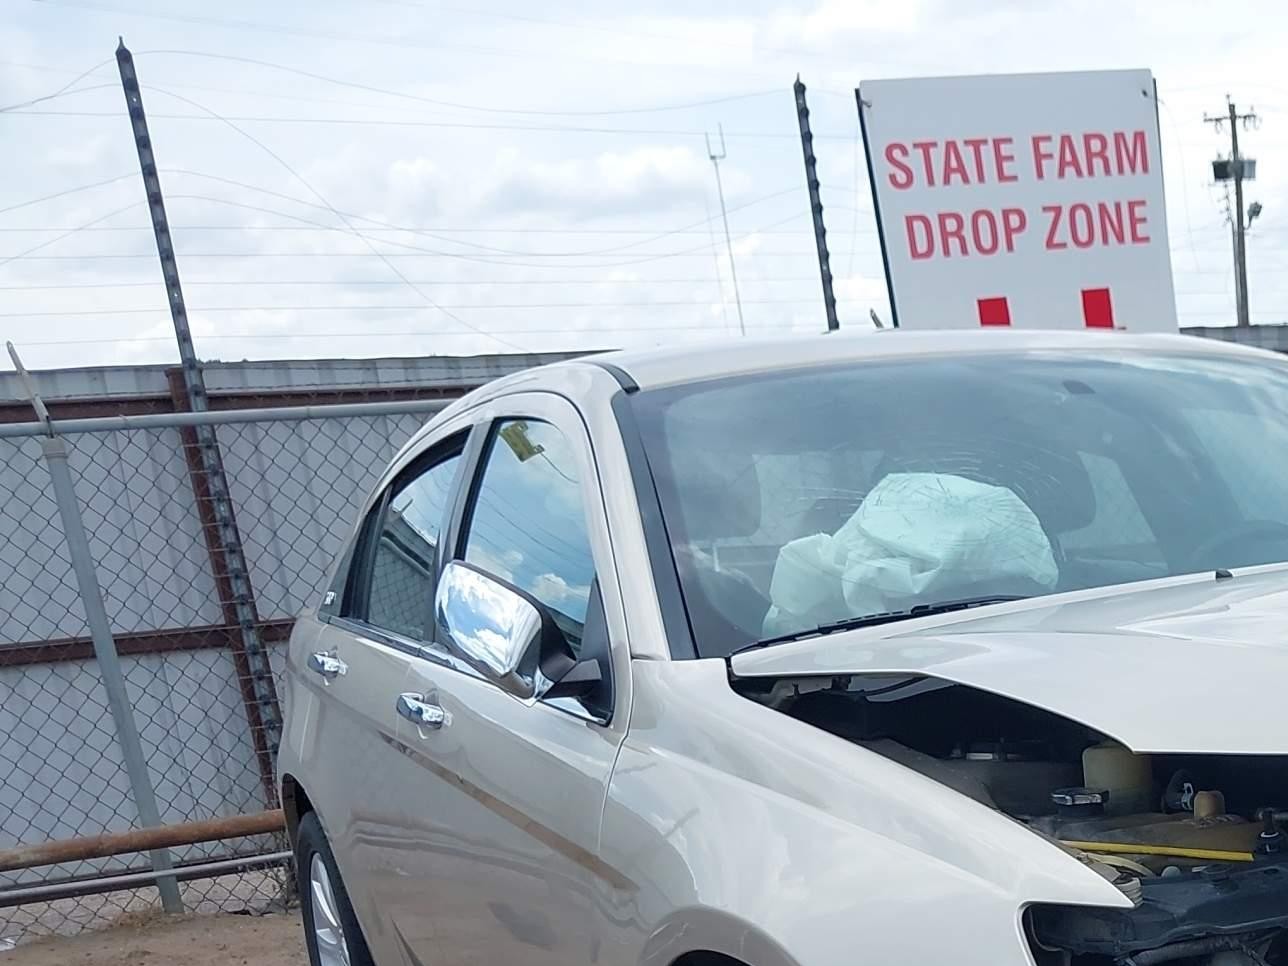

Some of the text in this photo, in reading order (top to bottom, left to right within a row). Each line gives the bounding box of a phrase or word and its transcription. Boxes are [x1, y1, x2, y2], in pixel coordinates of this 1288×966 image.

[884, 130, 1150, 190] STATE FARM
[904, 200, 1151, 260] DROP ZONE
